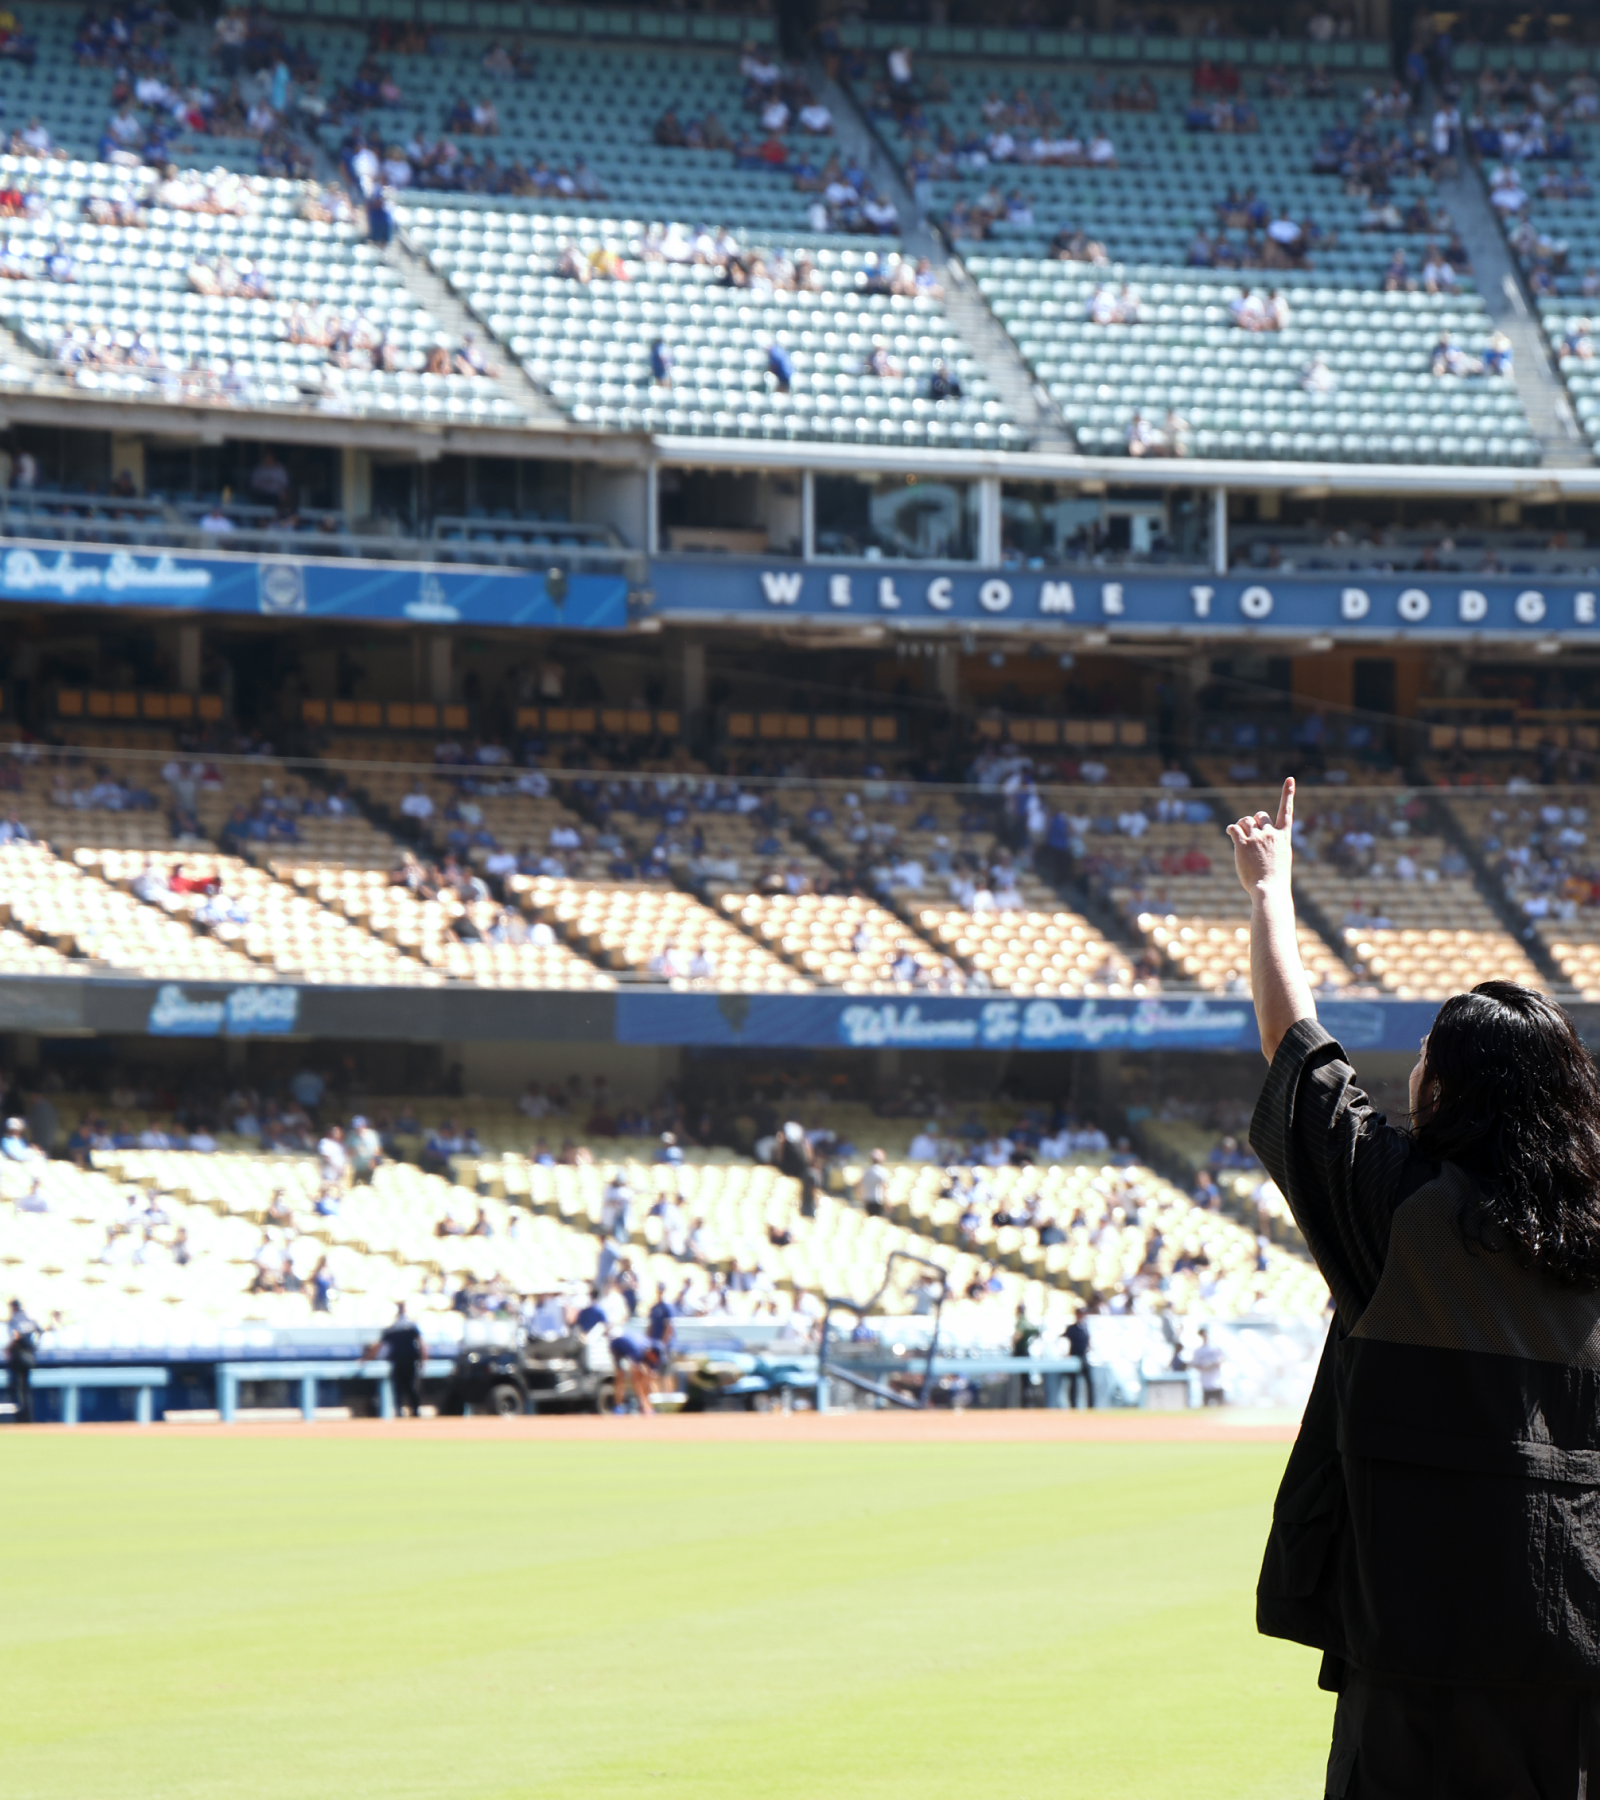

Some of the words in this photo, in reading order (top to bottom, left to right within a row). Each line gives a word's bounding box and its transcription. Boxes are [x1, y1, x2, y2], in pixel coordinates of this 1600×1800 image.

[762, 572, 1123, 615] WELCOME
[1192, 586, 1273, 617] TO
[152, 985, 224, 1026] Since
[841, 1004, 977, 1046] Welcome
[1131, 998, 1247, 1036] Stadium
